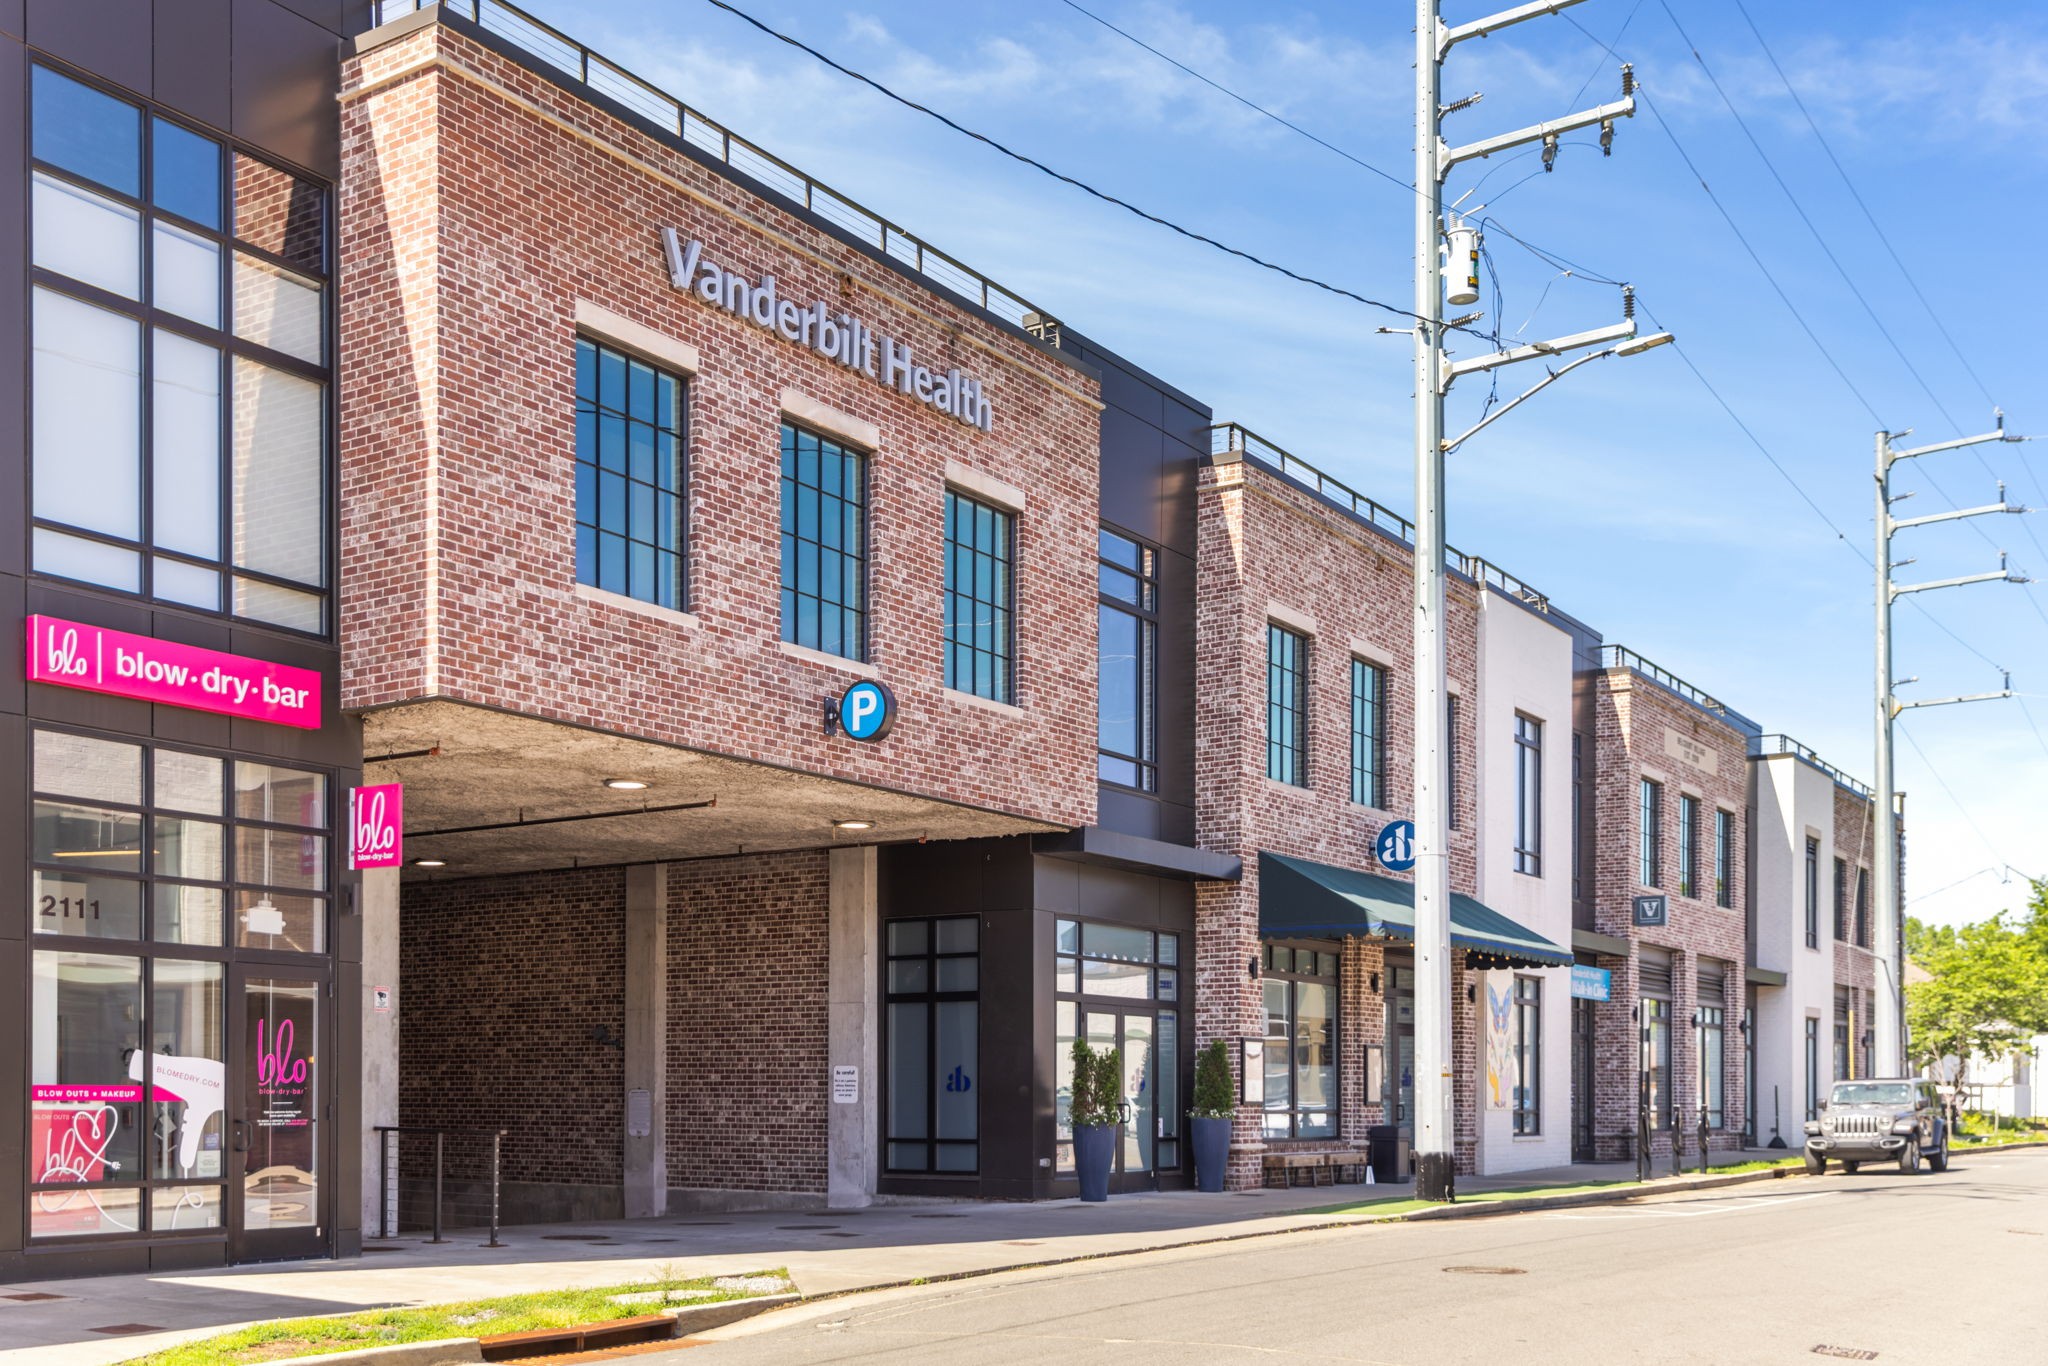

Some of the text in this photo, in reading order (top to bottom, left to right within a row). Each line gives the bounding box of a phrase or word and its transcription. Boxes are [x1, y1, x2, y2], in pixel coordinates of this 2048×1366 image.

[660, 227, 993, 433] Vanderbilt Health
[48, 625, 88, 676] blo
[852, 690, 878, 732] P
[357, 791, 395, 853] blo
[41, 894, 99, 920] 2111
[257, 1018, 307, 1087] blo
[101, 1090, 136, 1098] MAKEUP
[156, 1065, 220, 1089] BLOMEDRY.COM
